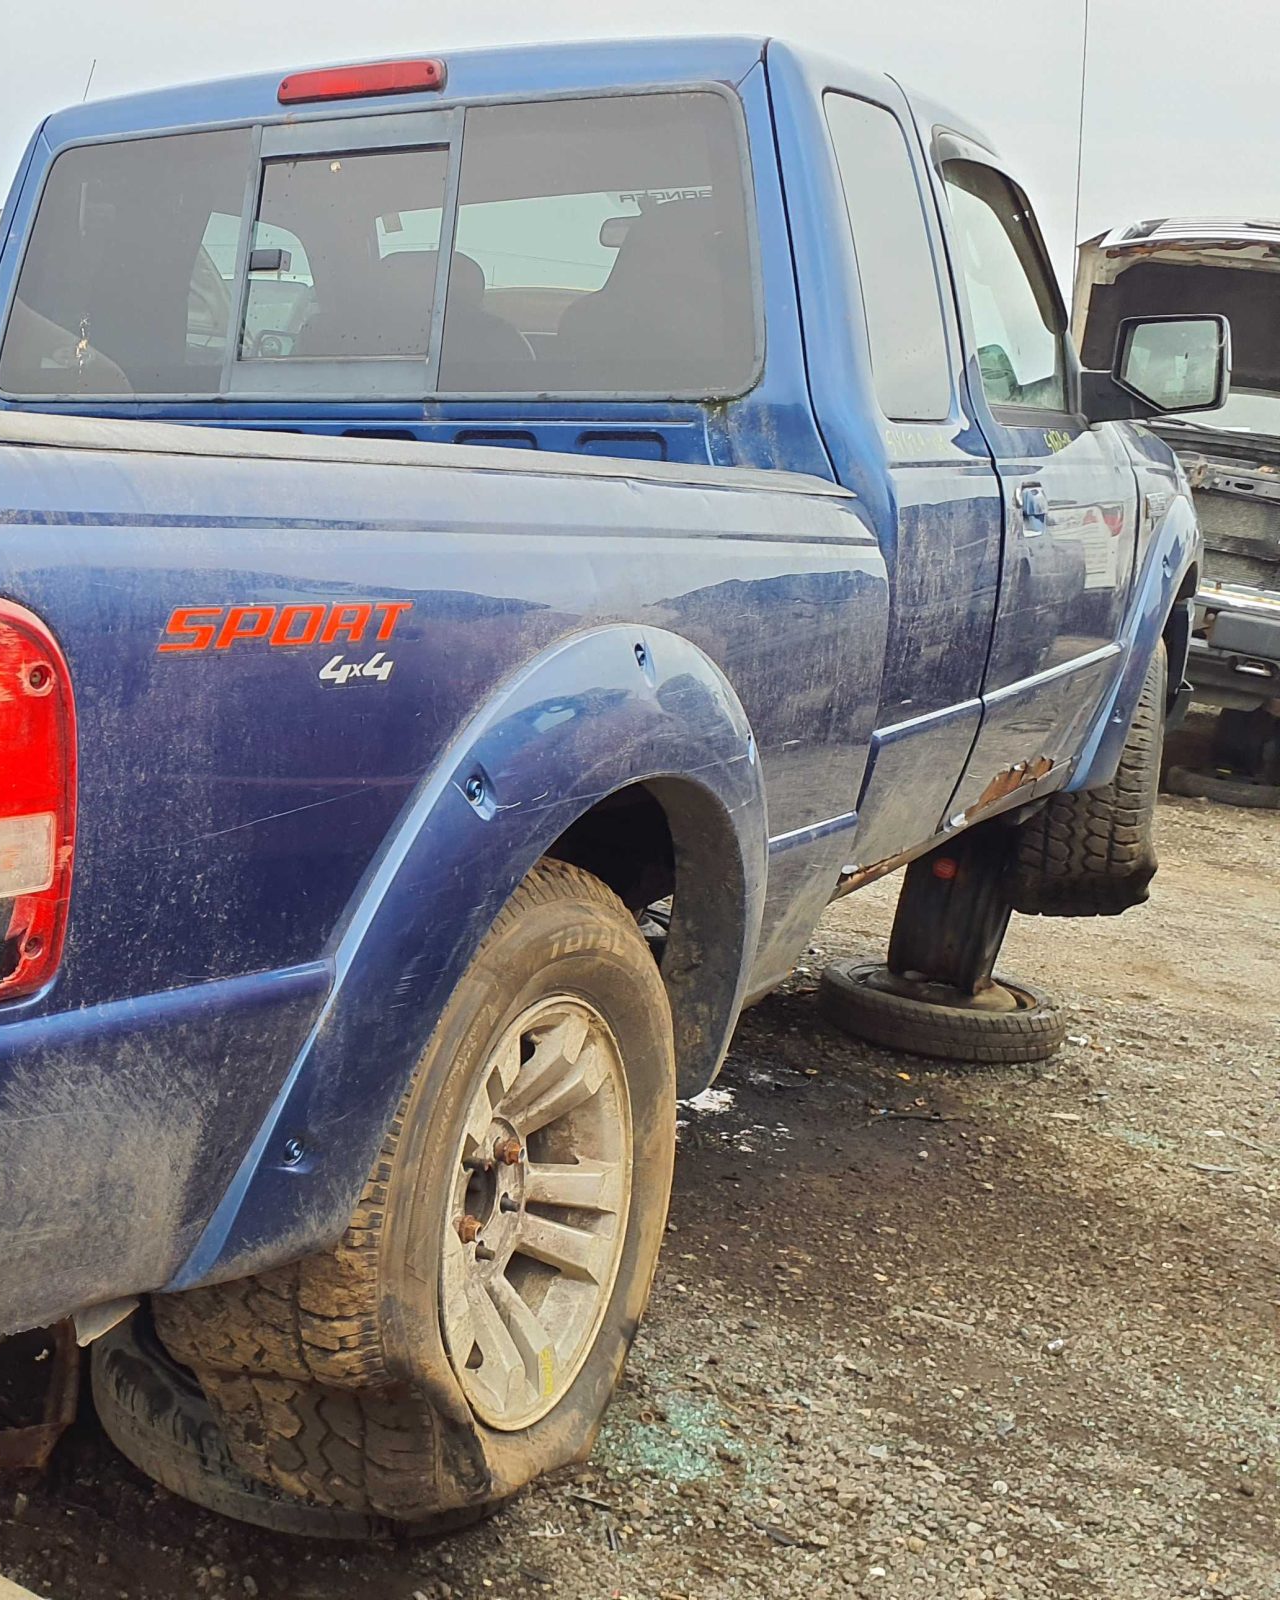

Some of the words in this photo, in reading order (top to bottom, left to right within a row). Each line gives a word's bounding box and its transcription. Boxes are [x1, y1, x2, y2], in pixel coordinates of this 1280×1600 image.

[157, 602, 414, 652] SPORT
[319, 652, 394, 684] 4x4
[549, 924, 625, 960] TOTAL
